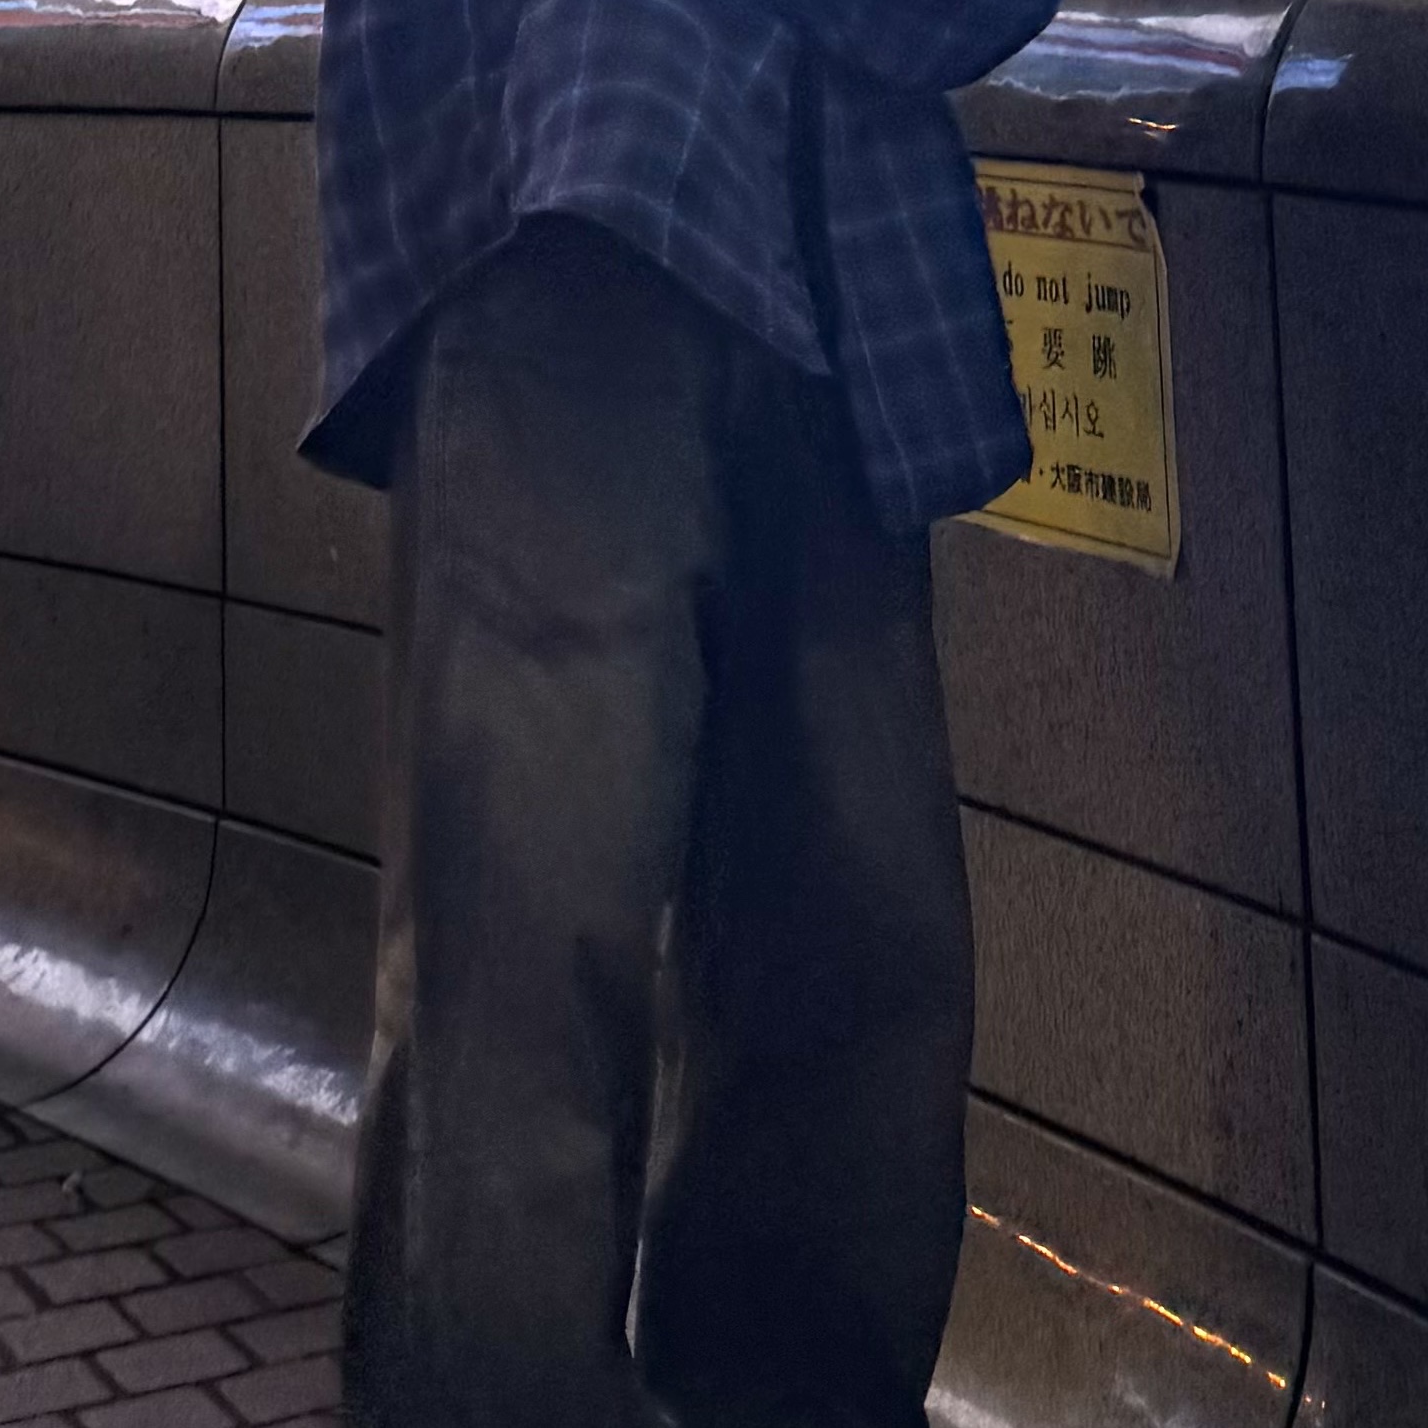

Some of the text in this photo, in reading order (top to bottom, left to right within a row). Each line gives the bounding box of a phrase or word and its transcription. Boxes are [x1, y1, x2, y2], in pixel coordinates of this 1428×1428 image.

[1002, 261, 1131, 322] do not jump
